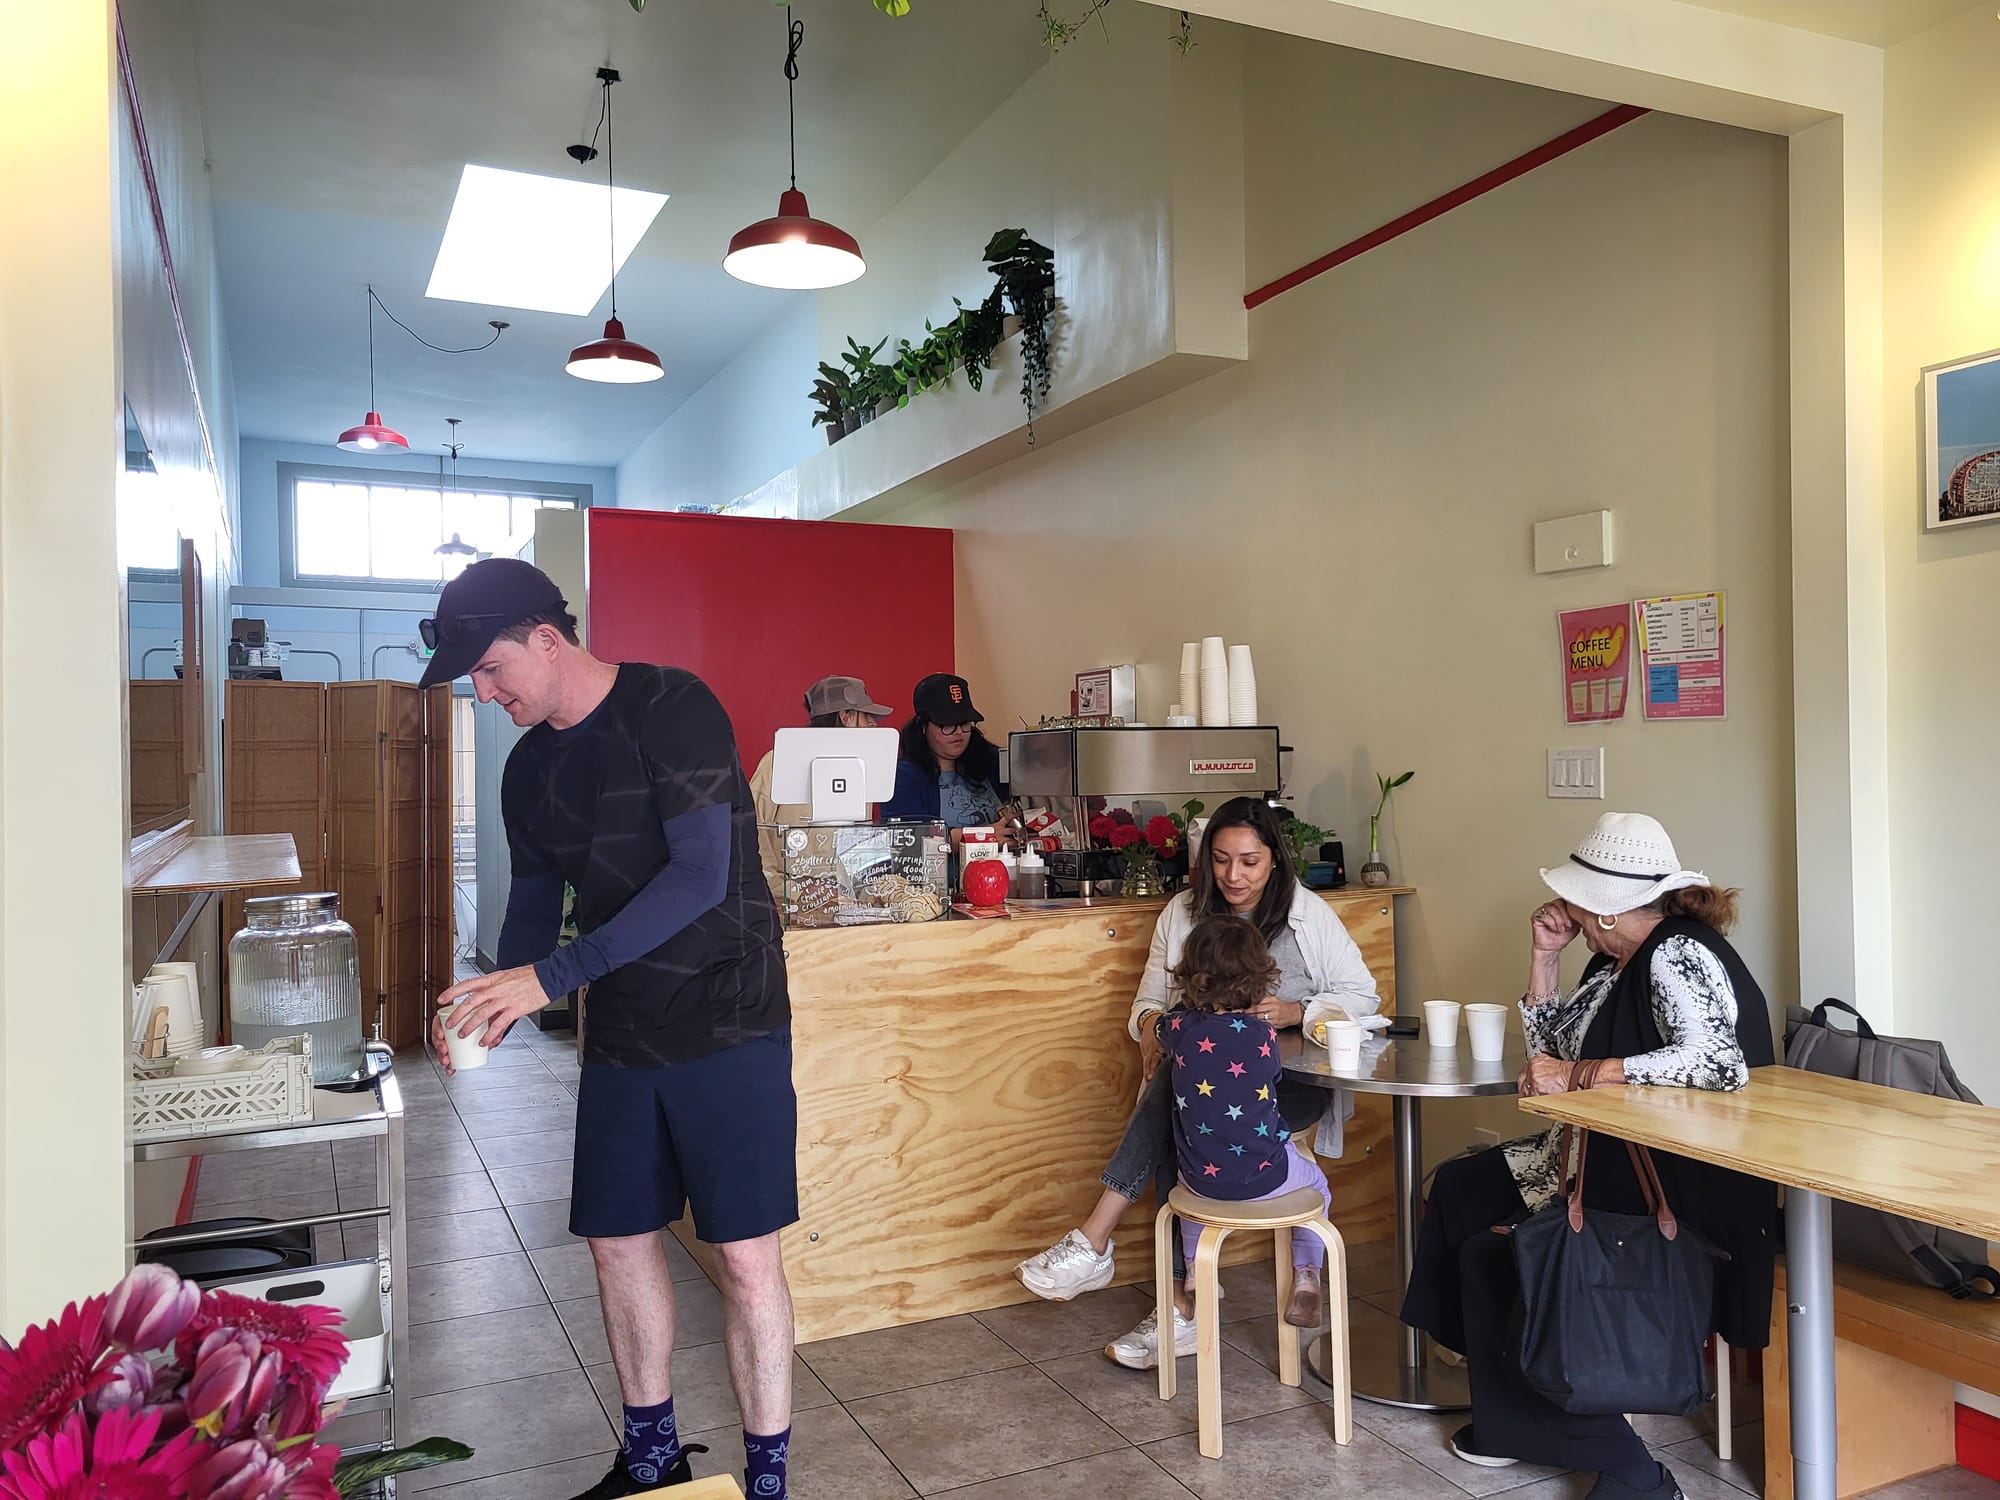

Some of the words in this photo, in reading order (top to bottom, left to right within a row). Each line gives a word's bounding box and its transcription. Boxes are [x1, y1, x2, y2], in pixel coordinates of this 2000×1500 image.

[1569, 637, 1611, 654] COFFEE
[1570, 654, 1604, 669] MENU
[949, 684, 963, 704] SF
[800, 855, 824, 866] butter
[796, 878, 814, 892] ham
[800, 886, 825, 903] cheese
[801, 888, 835, 912] croissant
